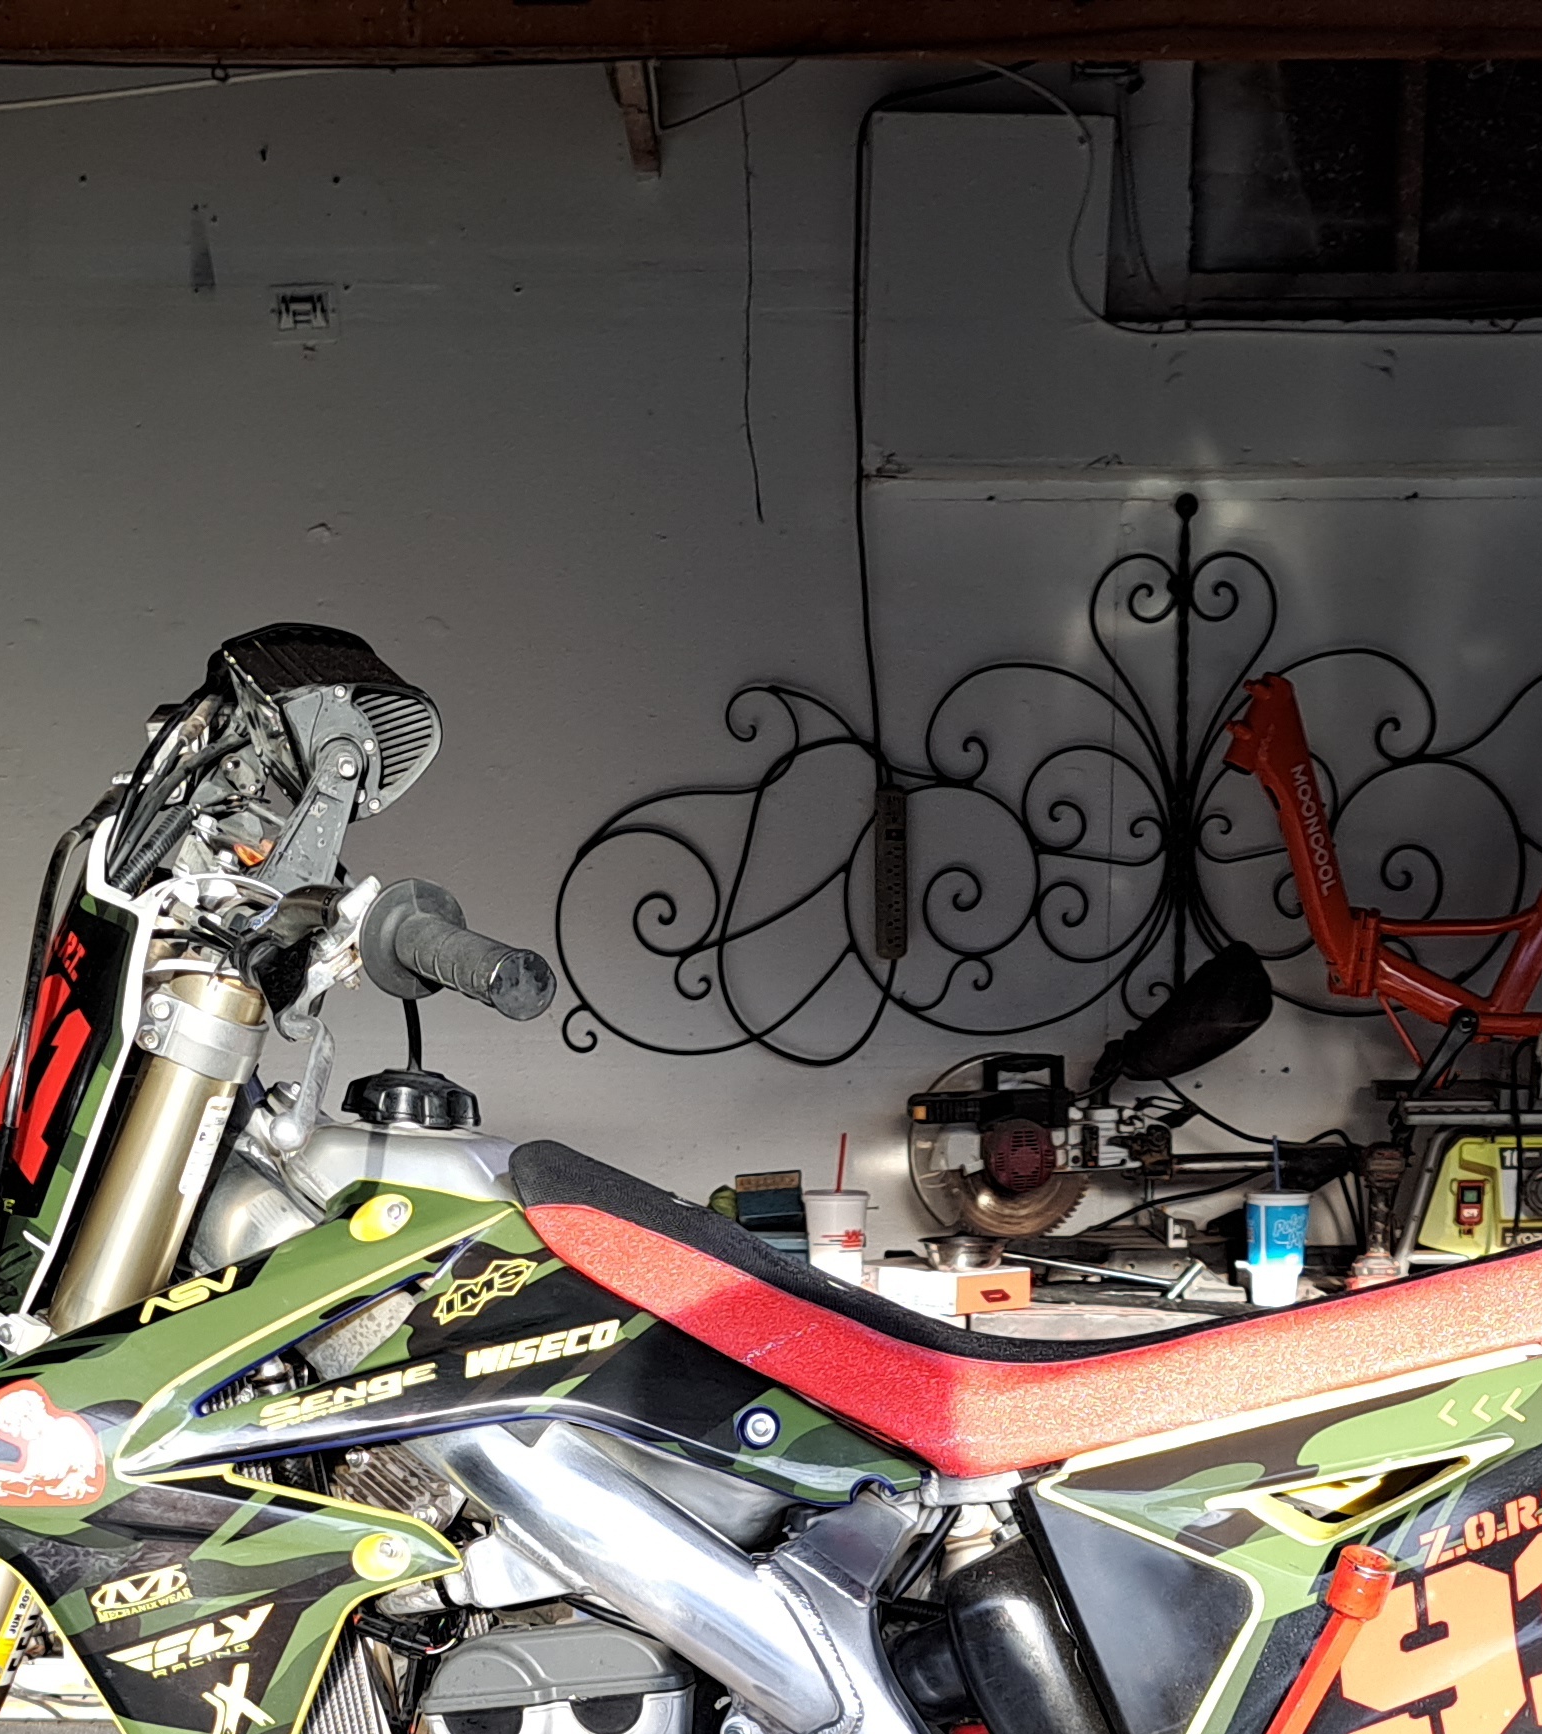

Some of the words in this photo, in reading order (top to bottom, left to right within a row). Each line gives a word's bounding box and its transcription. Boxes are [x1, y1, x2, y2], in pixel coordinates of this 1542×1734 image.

[139, 1265, 238, 1324] ASV
[442, 1259, 529, 1321] IMS
[465, 1319, 621, 1379] WISECO
[9, 1614, 23, 1634] JUN
[106, 1603, 275, 1671] FLY
[151, 1642, 250, 1679] RACING
